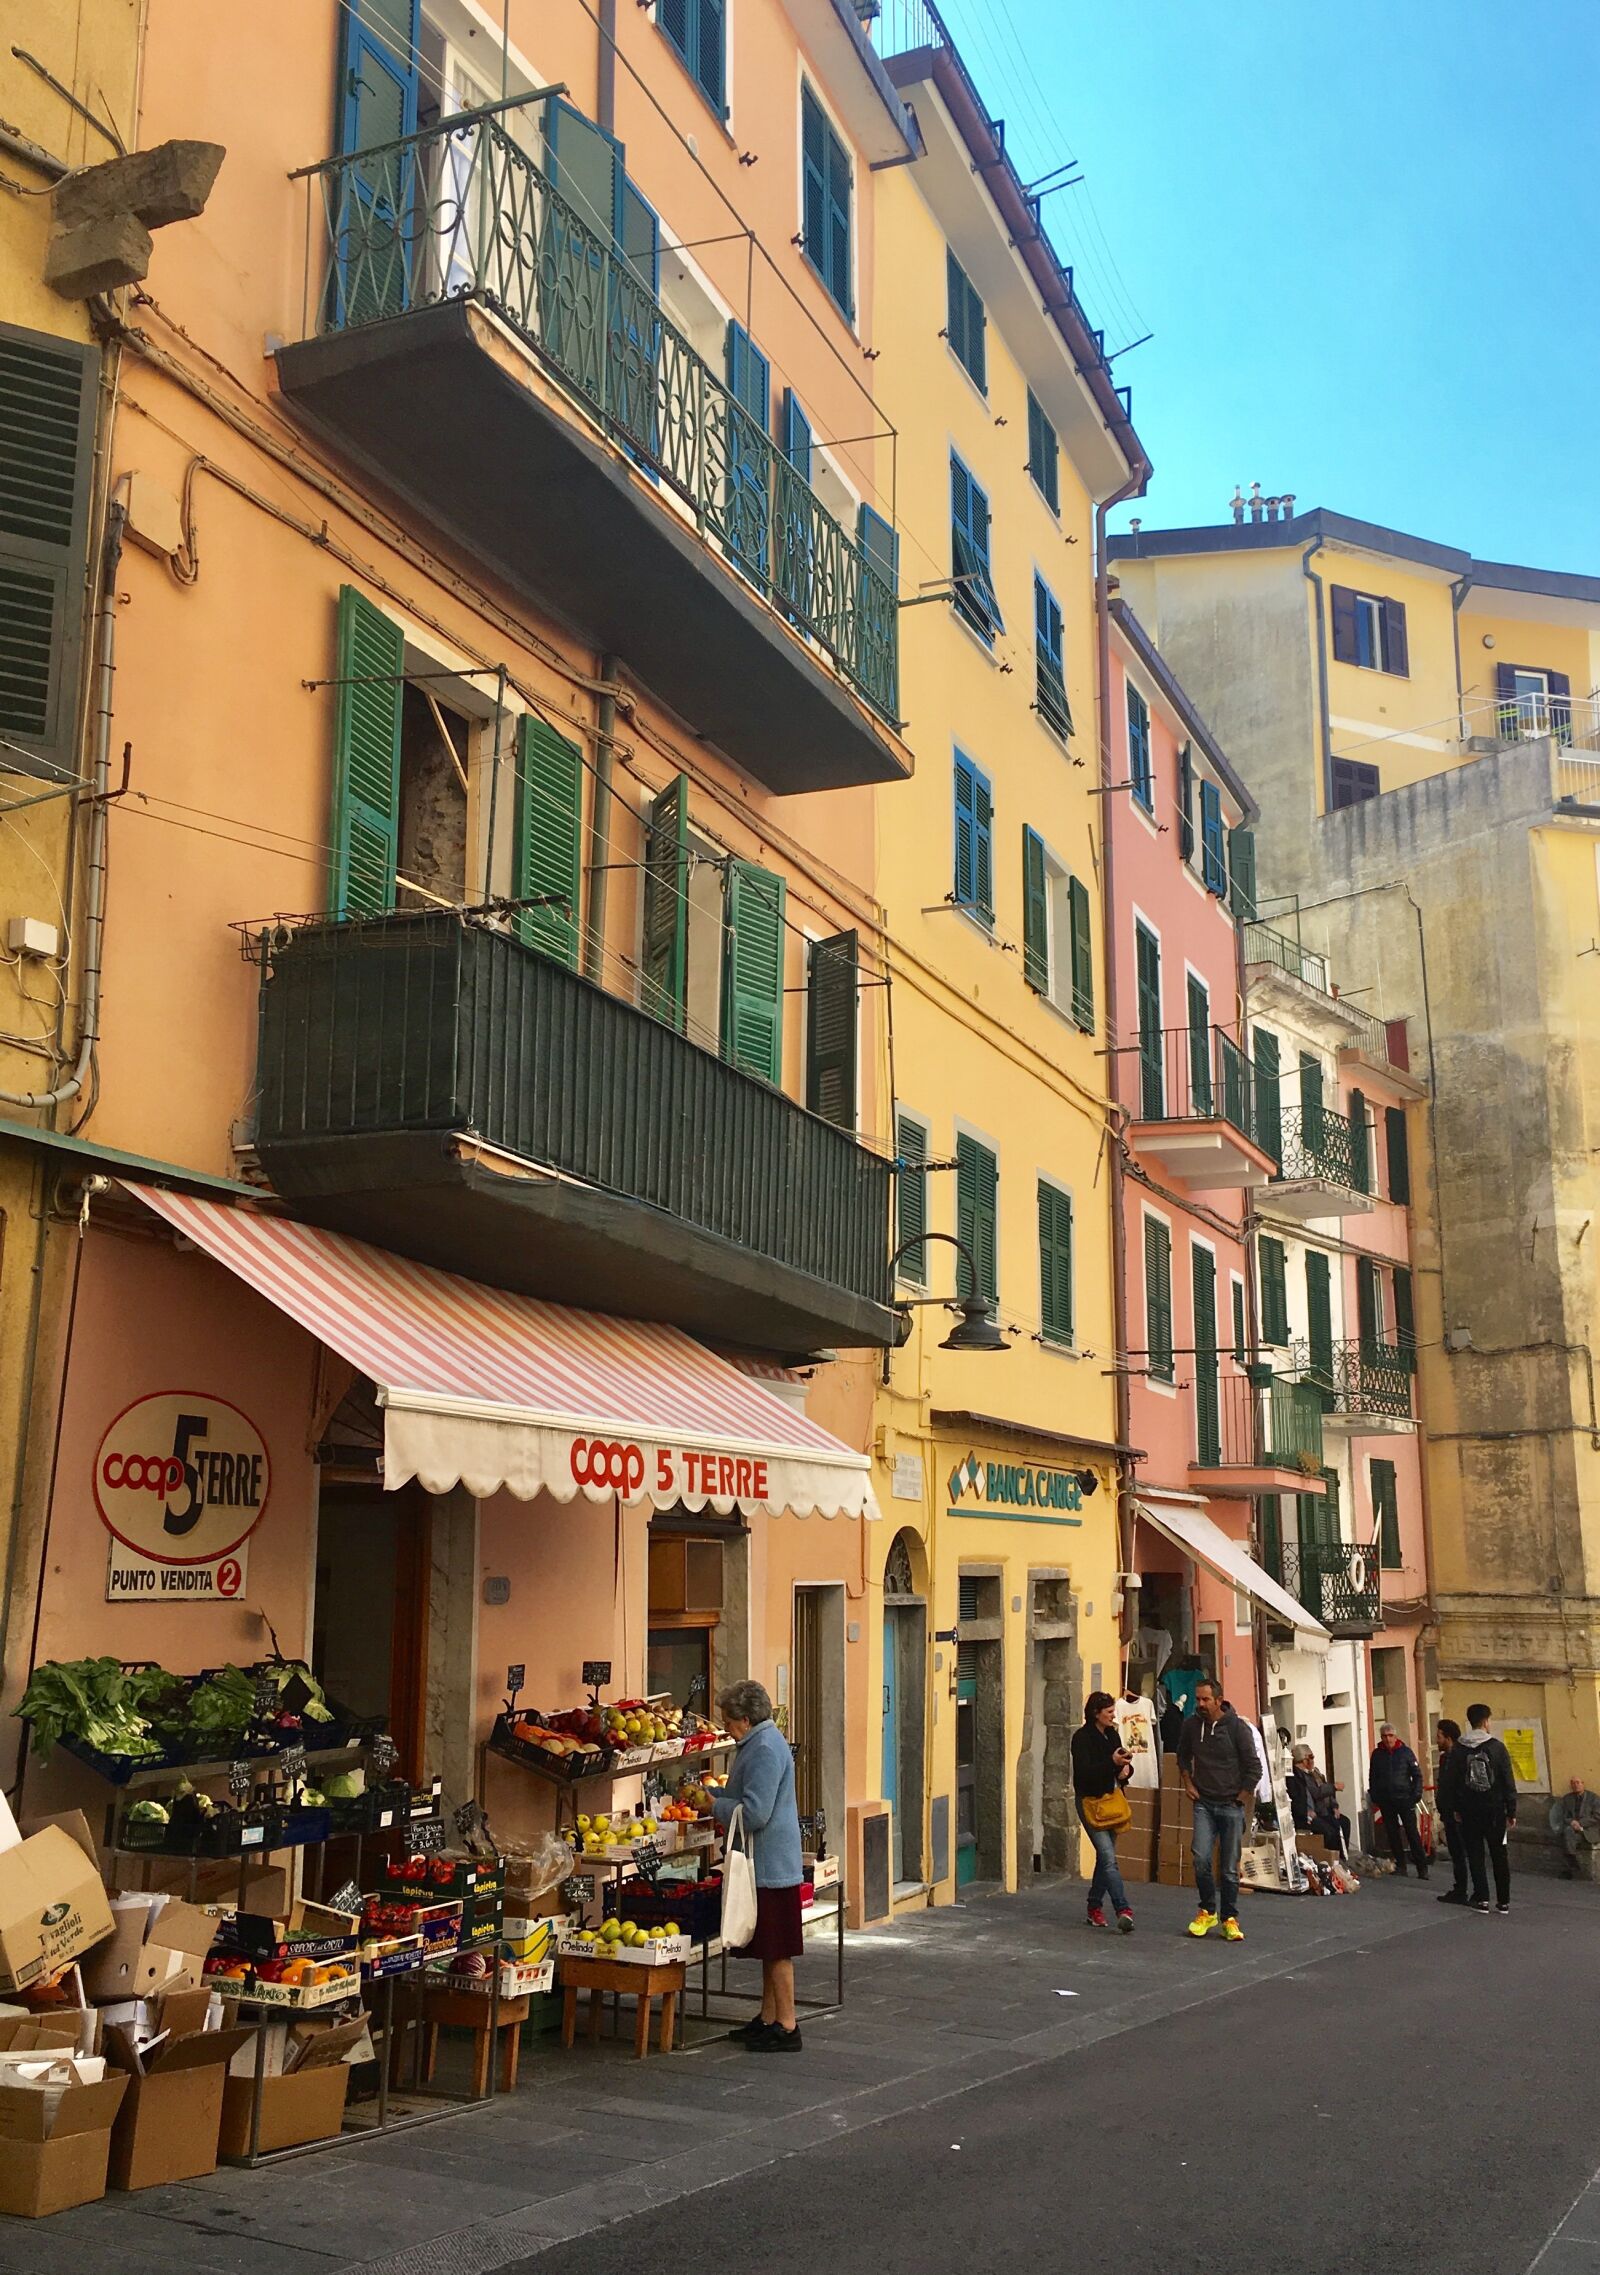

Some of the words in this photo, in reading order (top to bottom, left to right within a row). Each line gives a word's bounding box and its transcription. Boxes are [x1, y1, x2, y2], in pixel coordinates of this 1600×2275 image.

[163, 1414, 208, 1535] 5
[195, 1450, 262, 1506] TERRE
[657, 1449, 674, 1491] 5
[682, 1452, 769, 1499] TERRE
[986, 1462, 1036, 1506] BANCA
[1036, 1469, 1083, 1511] CARIGE
[112, 1570, 156, 1591] PUNTO
[160, 1570, 213, 1591] VENDITA
[221, 1562, 237, 1591] 2
[37, 1912, 82, 1946] Tvaglioli
[561, 1940, 593, 1954] Melinda
[661, 1944, 682, 1954] Melinda
